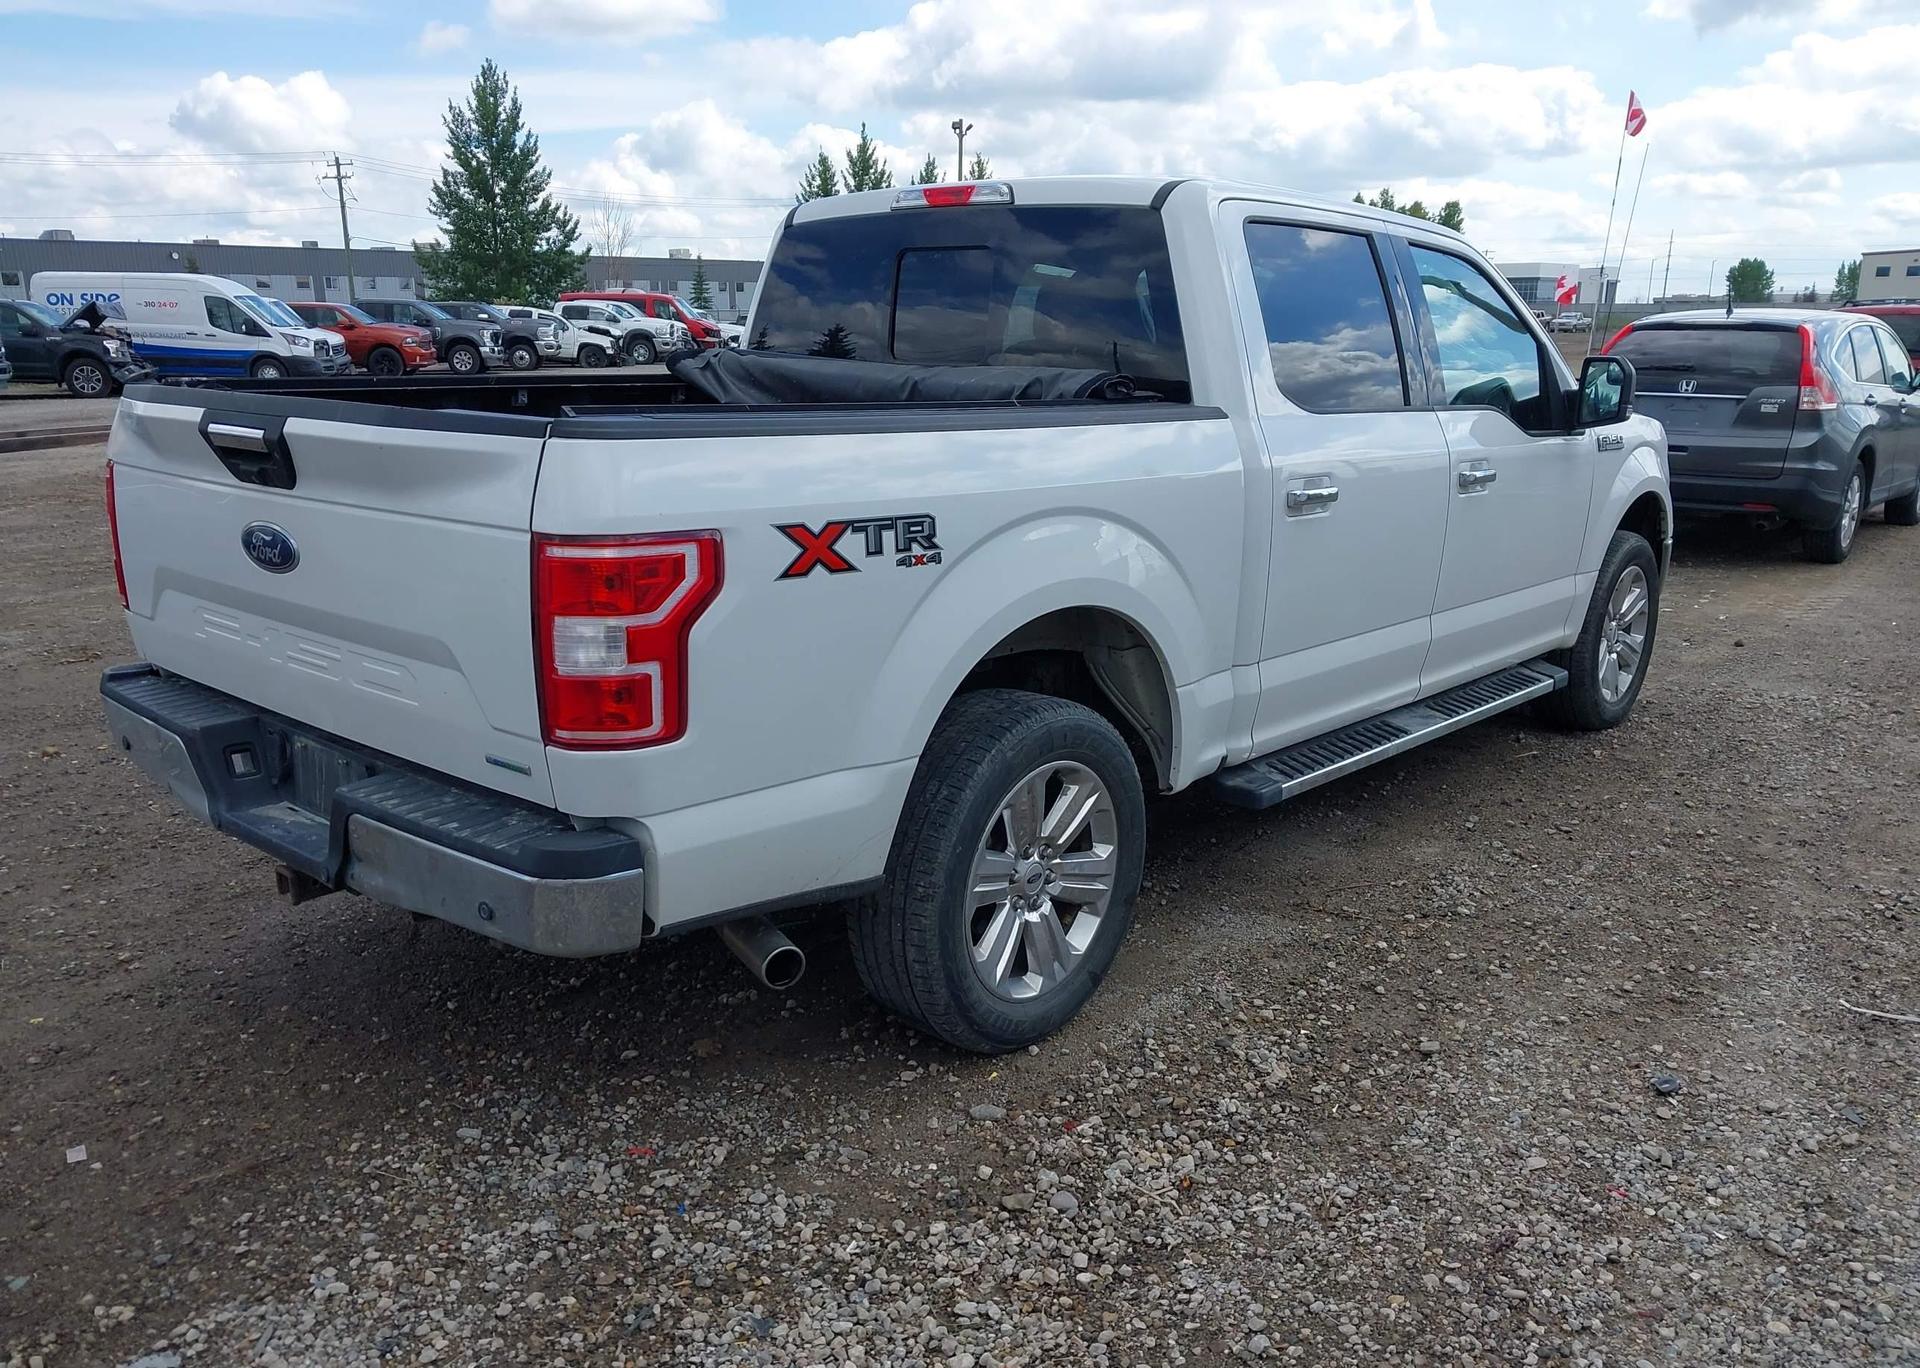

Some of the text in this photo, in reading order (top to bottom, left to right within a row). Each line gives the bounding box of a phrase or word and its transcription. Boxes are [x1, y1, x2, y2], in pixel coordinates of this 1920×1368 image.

[46, 293, 74, 306] ON
[250, 531, 282, 563] Ford
[769, 512, 945, 582] XTR
